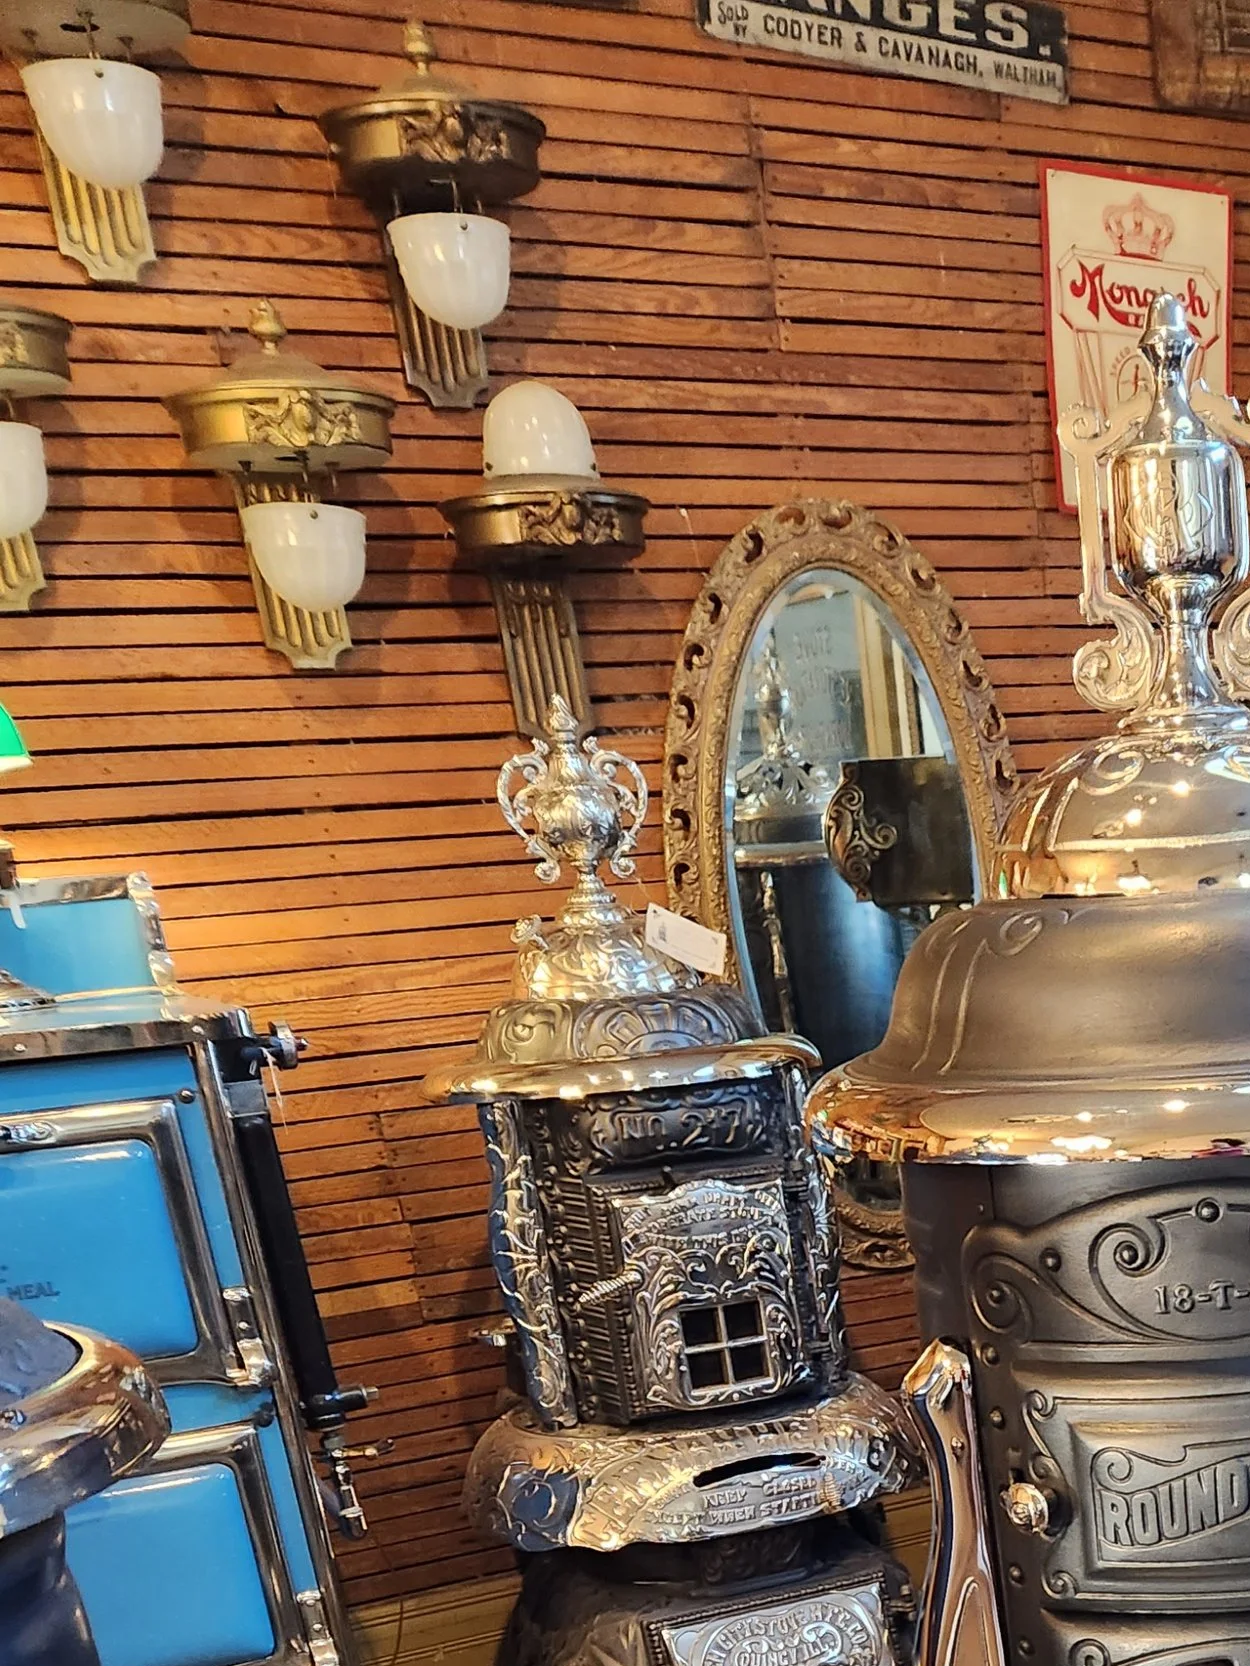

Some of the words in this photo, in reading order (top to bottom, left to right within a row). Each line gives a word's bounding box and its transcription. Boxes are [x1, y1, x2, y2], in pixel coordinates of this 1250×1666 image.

[717, 1, 749, 25] SOLD
[775, 0, 1052, 56] GES.
[855, 31, 867, 53] &
